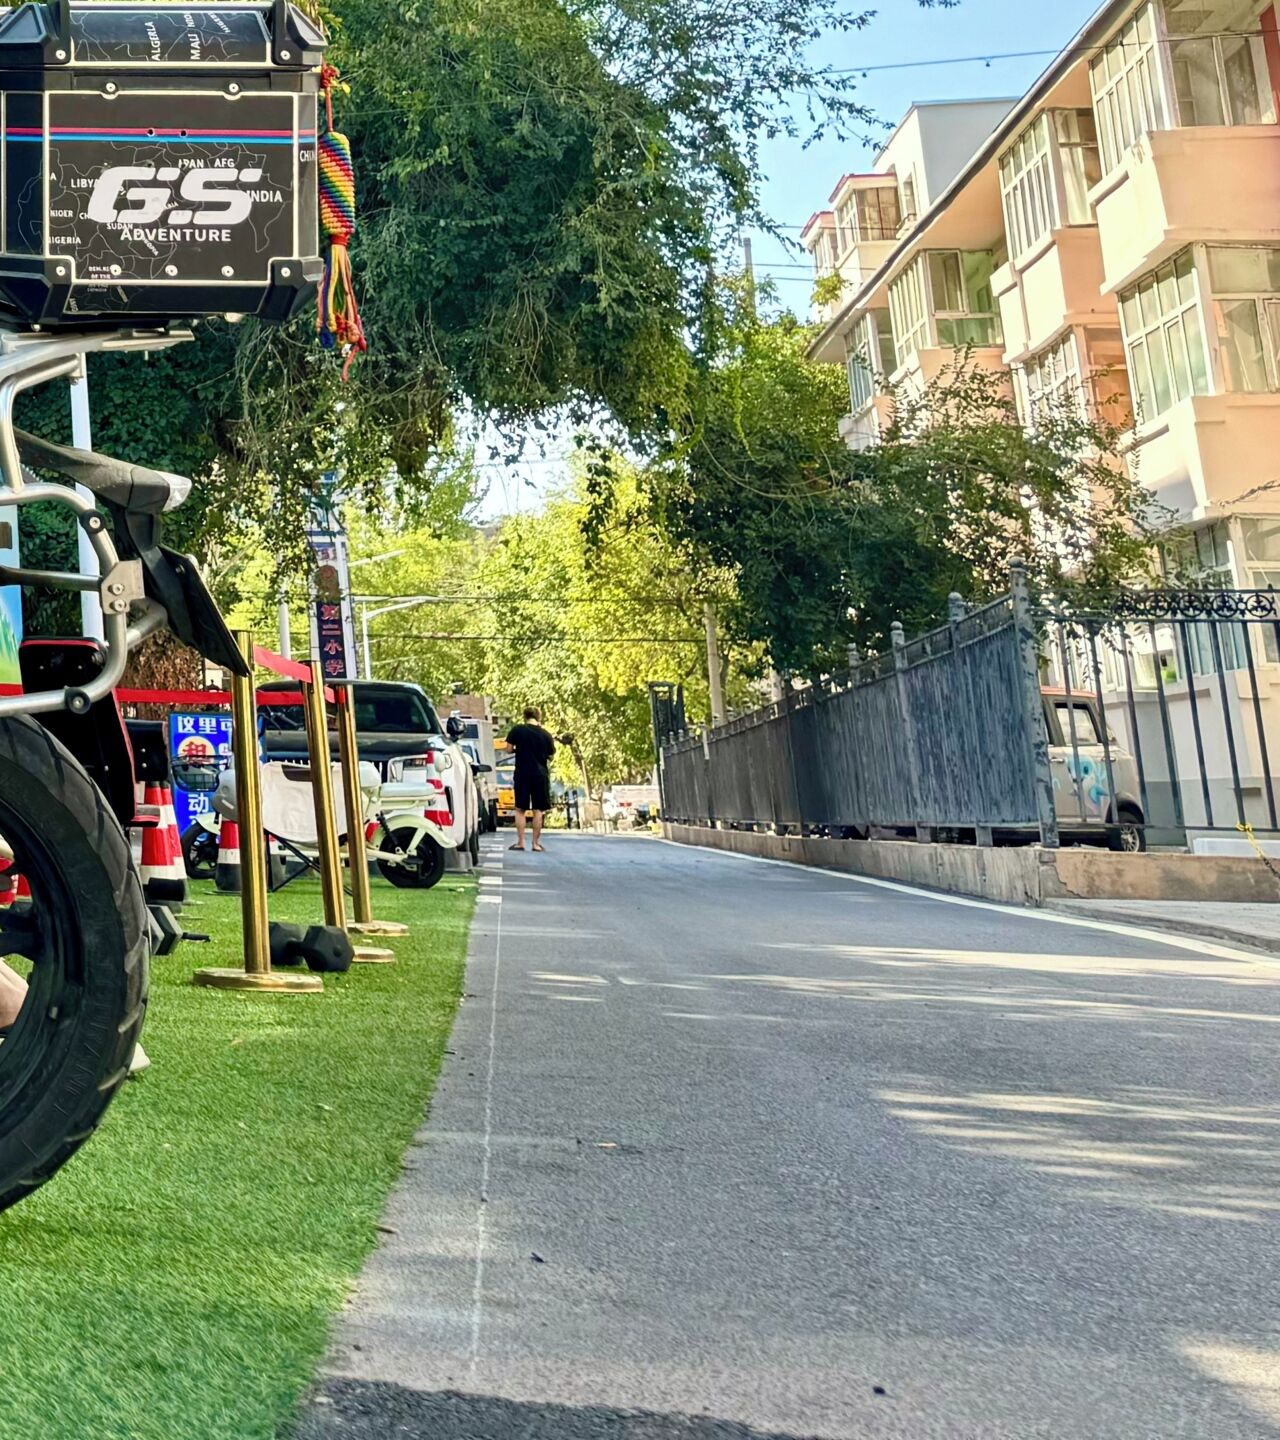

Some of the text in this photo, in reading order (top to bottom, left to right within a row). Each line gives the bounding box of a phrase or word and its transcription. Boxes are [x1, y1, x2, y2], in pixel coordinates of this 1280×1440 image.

[214, 158, 235, 168] AFG
[87, 166, 263, 225] GS
[120, 228, 232, 242] ADVENTURE
